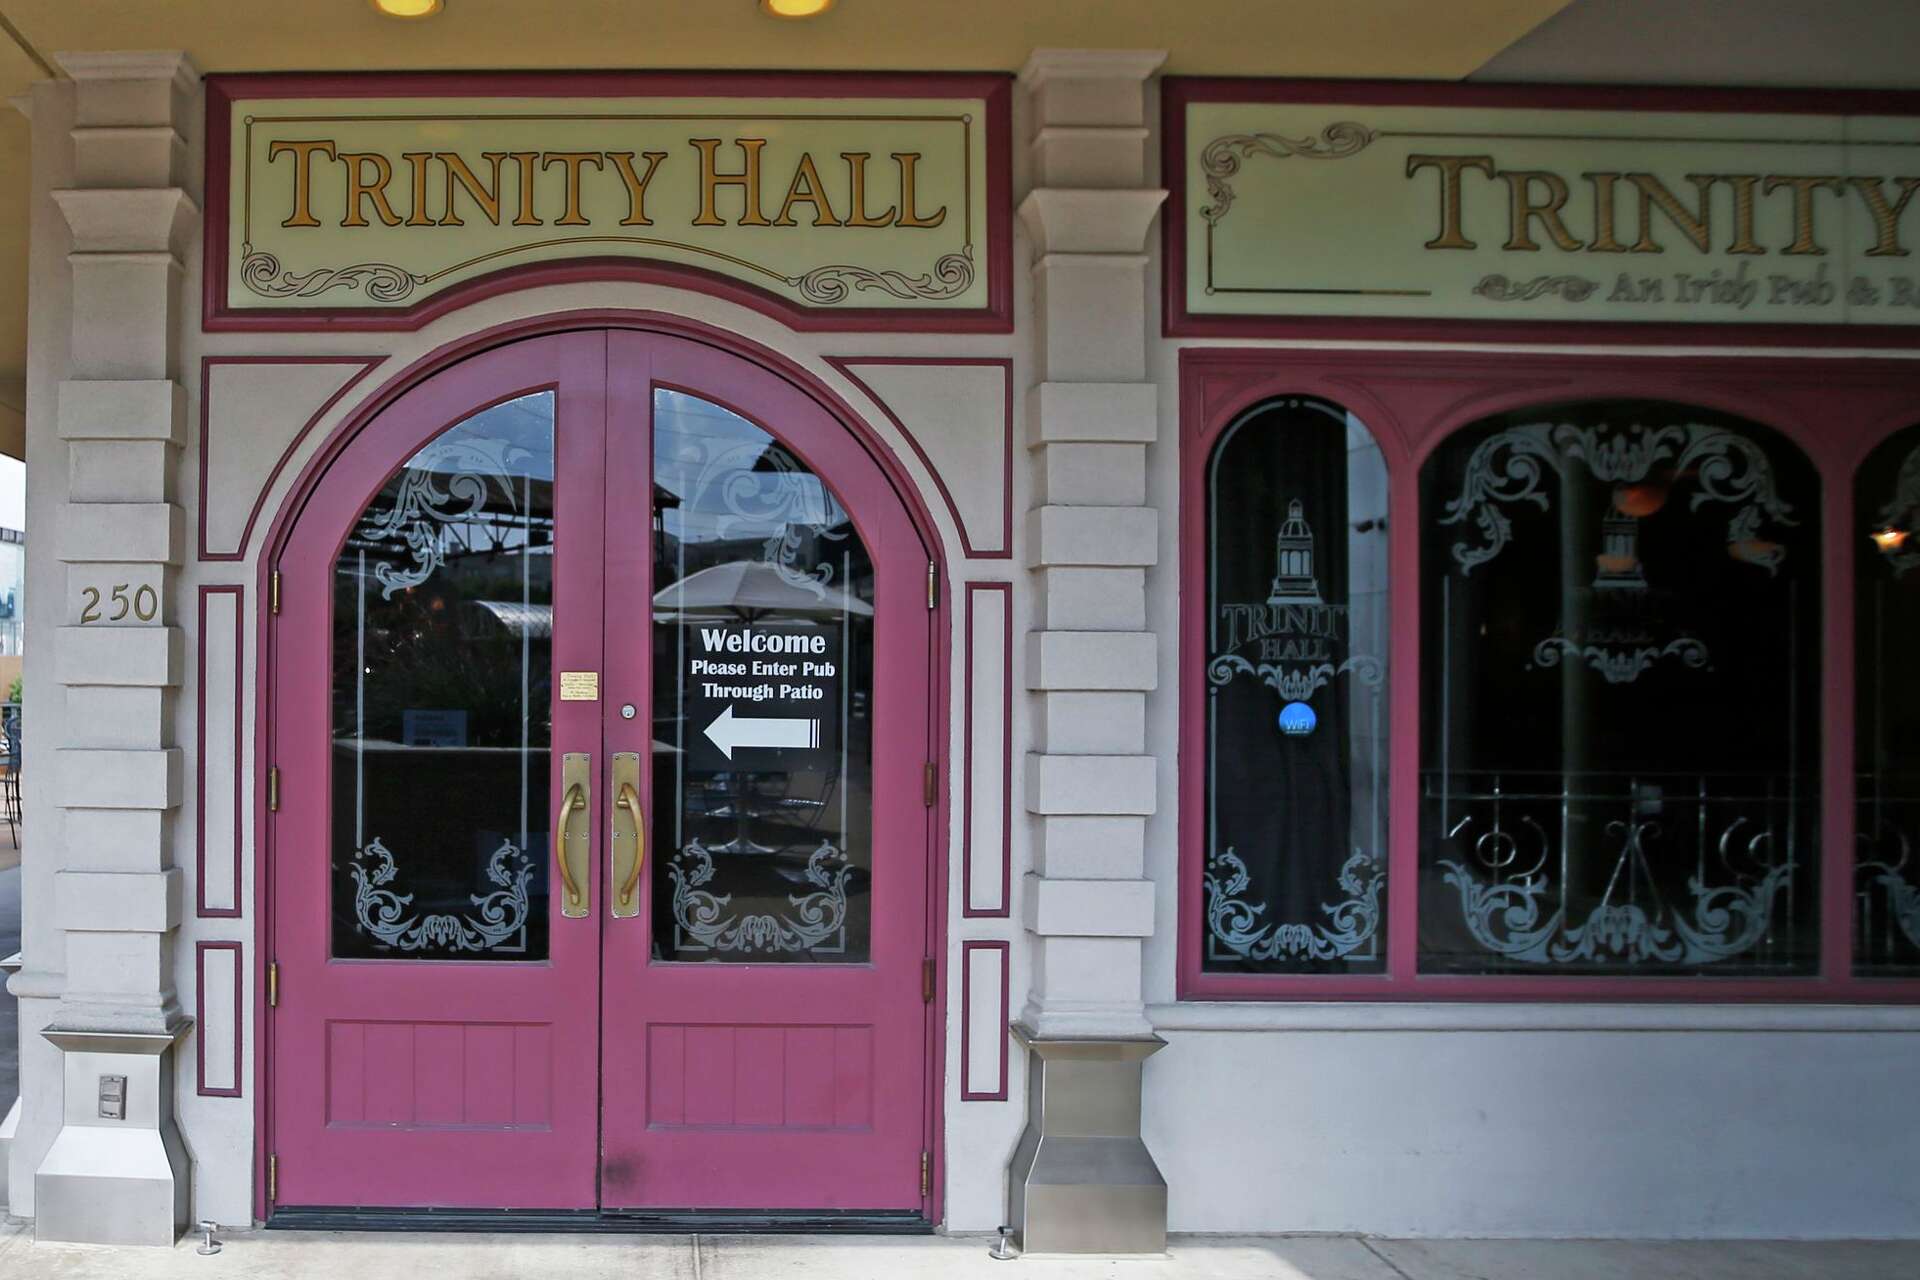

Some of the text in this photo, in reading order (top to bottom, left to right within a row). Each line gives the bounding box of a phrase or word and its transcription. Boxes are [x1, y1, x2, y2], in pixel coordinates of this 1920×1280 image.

[268, 138, 948, 229] TRINITY HALL
[1767, 262, 1837, 306] Pub
[80, 583, 158, 624] 250
[700, 628, 826, 654] Welcome
[690, 659, 836, 677] Please Enter Pub
[701, 682, 824, 702] Through Patio
